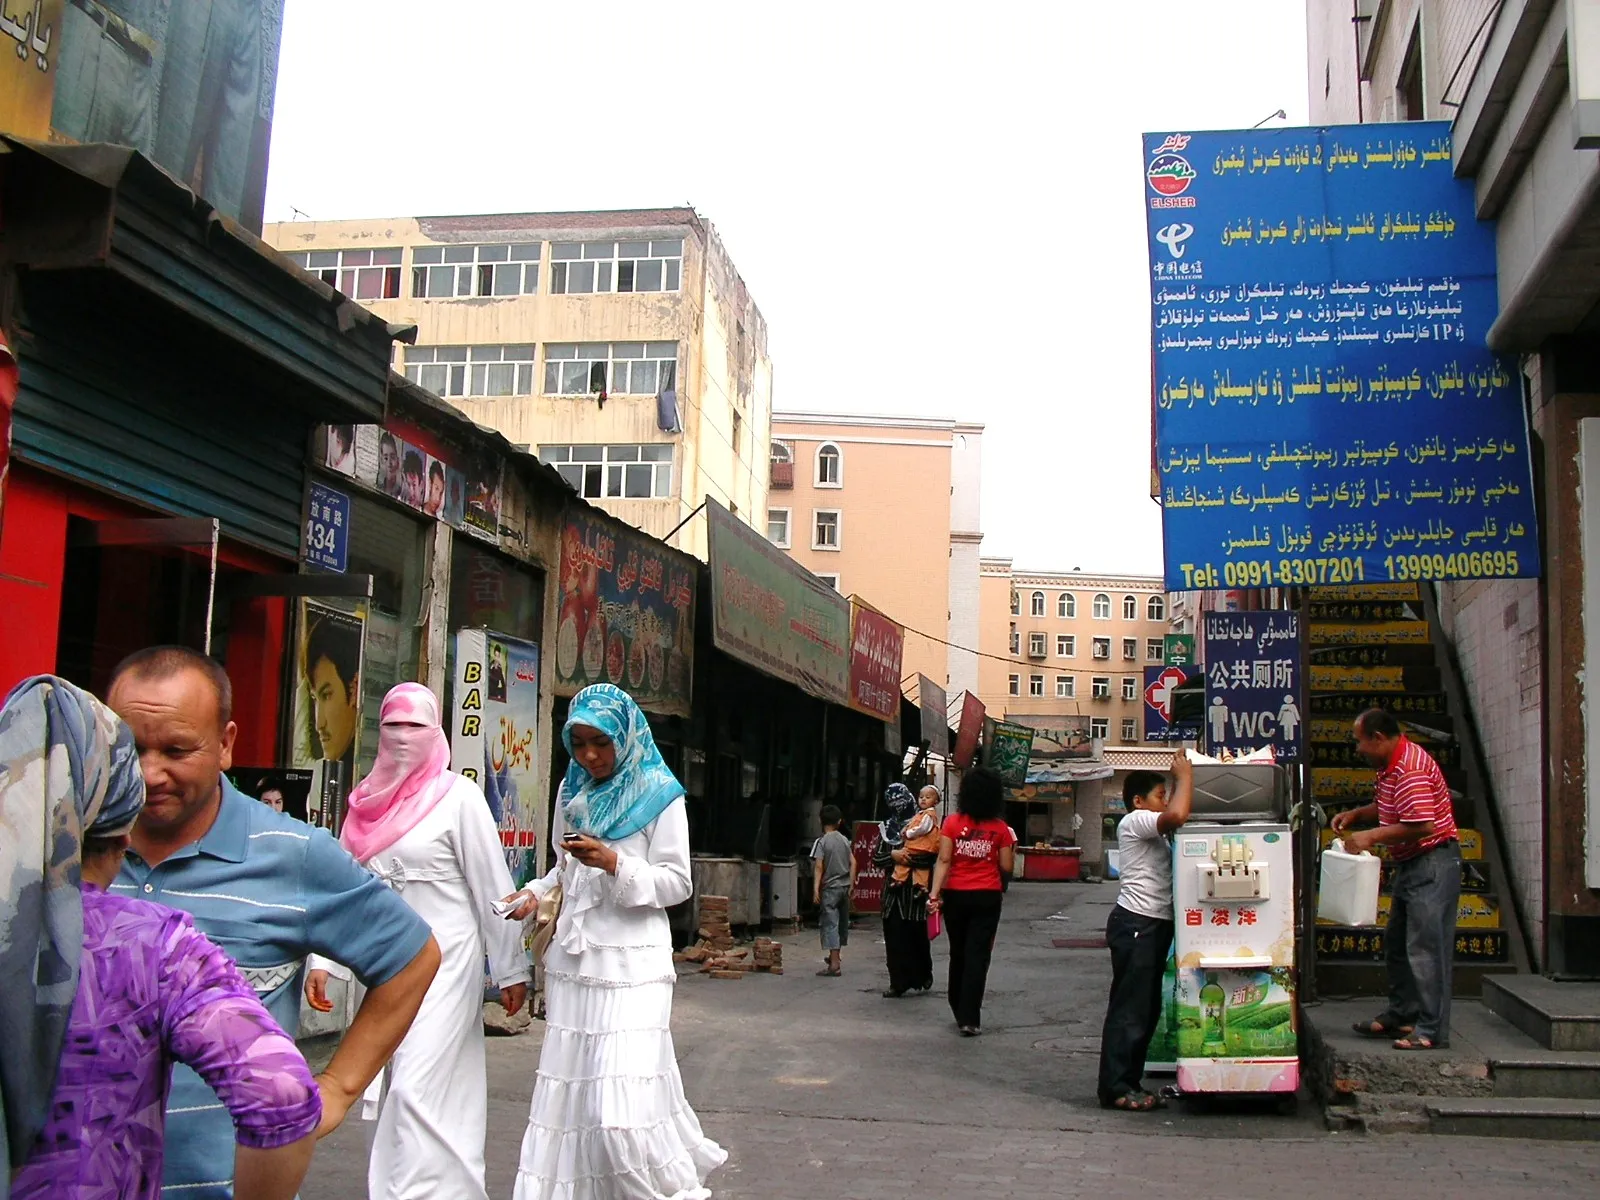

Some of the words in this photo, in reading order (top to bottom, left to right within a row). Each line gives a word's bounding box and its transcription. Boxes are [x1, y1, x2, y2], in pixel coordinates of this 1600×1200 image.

[1151, 197, 1196, 208] ELSHER
[1153, 261, 1203, 276] 中国电信
[1456, 323, 1464, 341] ۋە
[1272, 369, 1282, 404] ۋە
[1180, 563, 1219, 588] Tel:
[1224, 556, 1364, 587] 0991-8307201
[1384, 551, 1518, 580] 13999406695
[1209, 659, 1293, 690] 公共厕所
[1231, 711, 1276, 739] WC
[955, 838, 992, 853] WONDER
